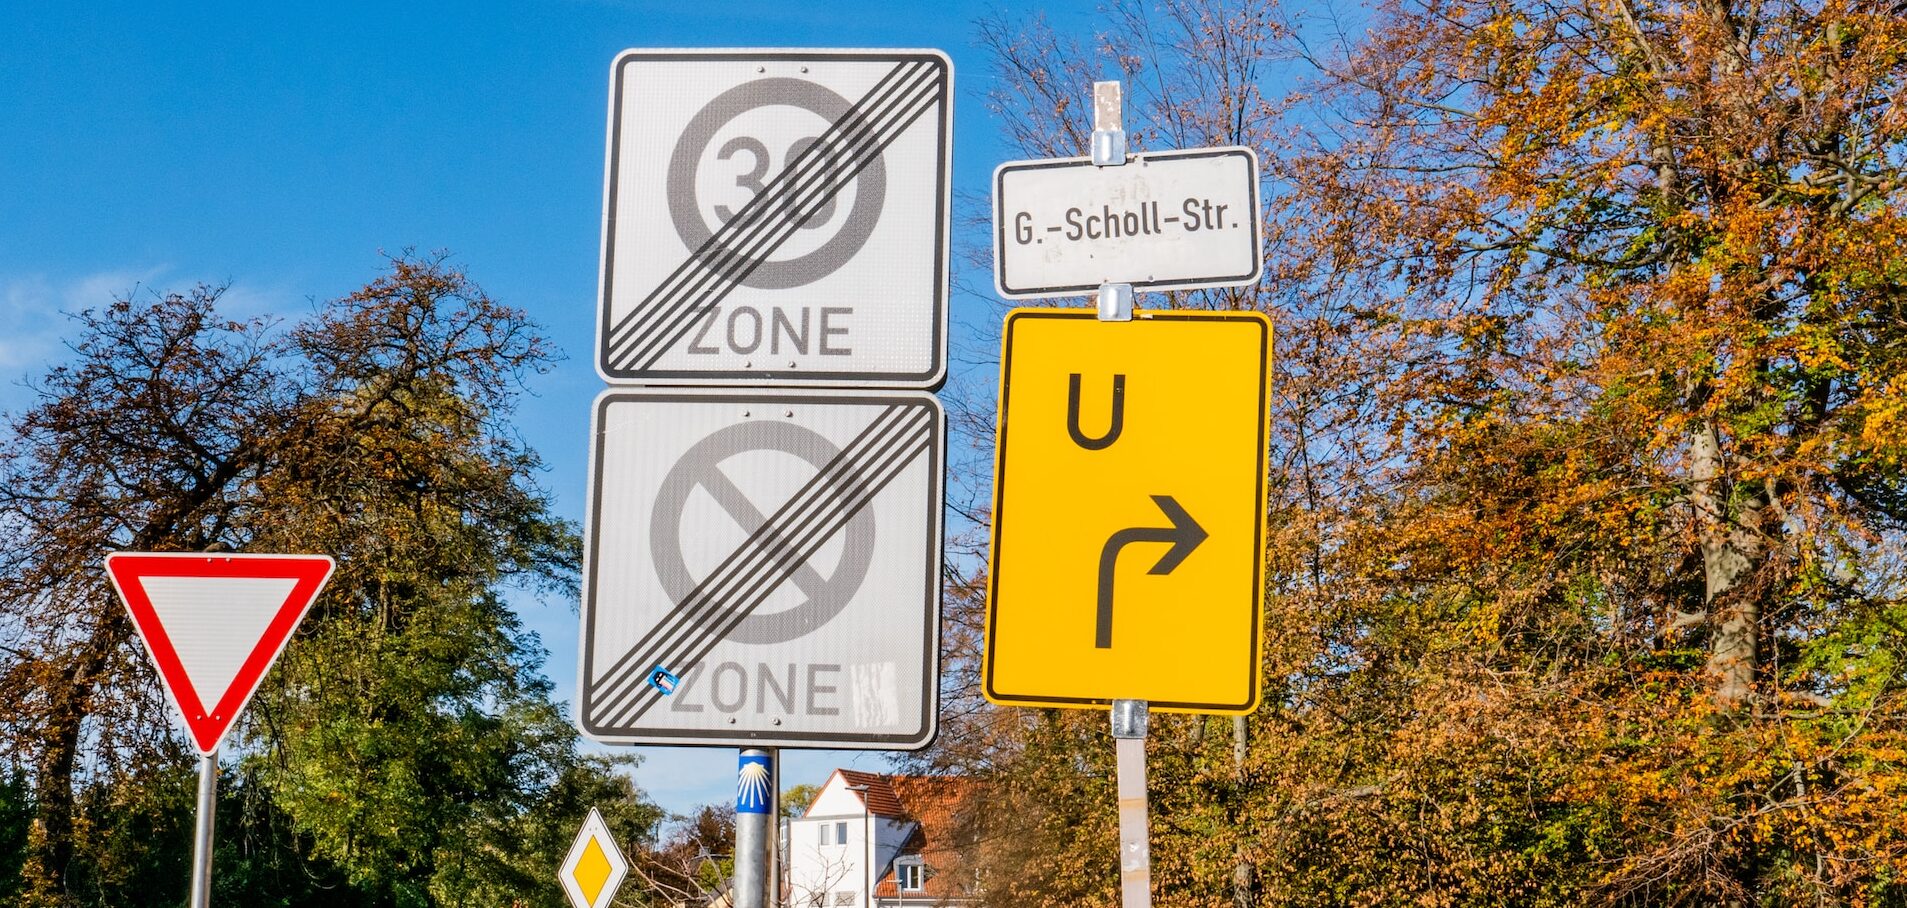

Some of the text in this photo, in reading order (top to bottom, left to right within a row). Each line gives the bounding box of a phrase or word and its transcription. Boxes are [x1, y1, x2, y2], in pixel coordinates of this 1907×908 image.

[714, 136, 839, 230] 30
[1015, 198, 1238, 245] G.-Scholl-Str.
[687, 305, 853, 356] ZONE
[1066, 373, 1126, 451] U
[670, 661, 841, 716] ZONE
